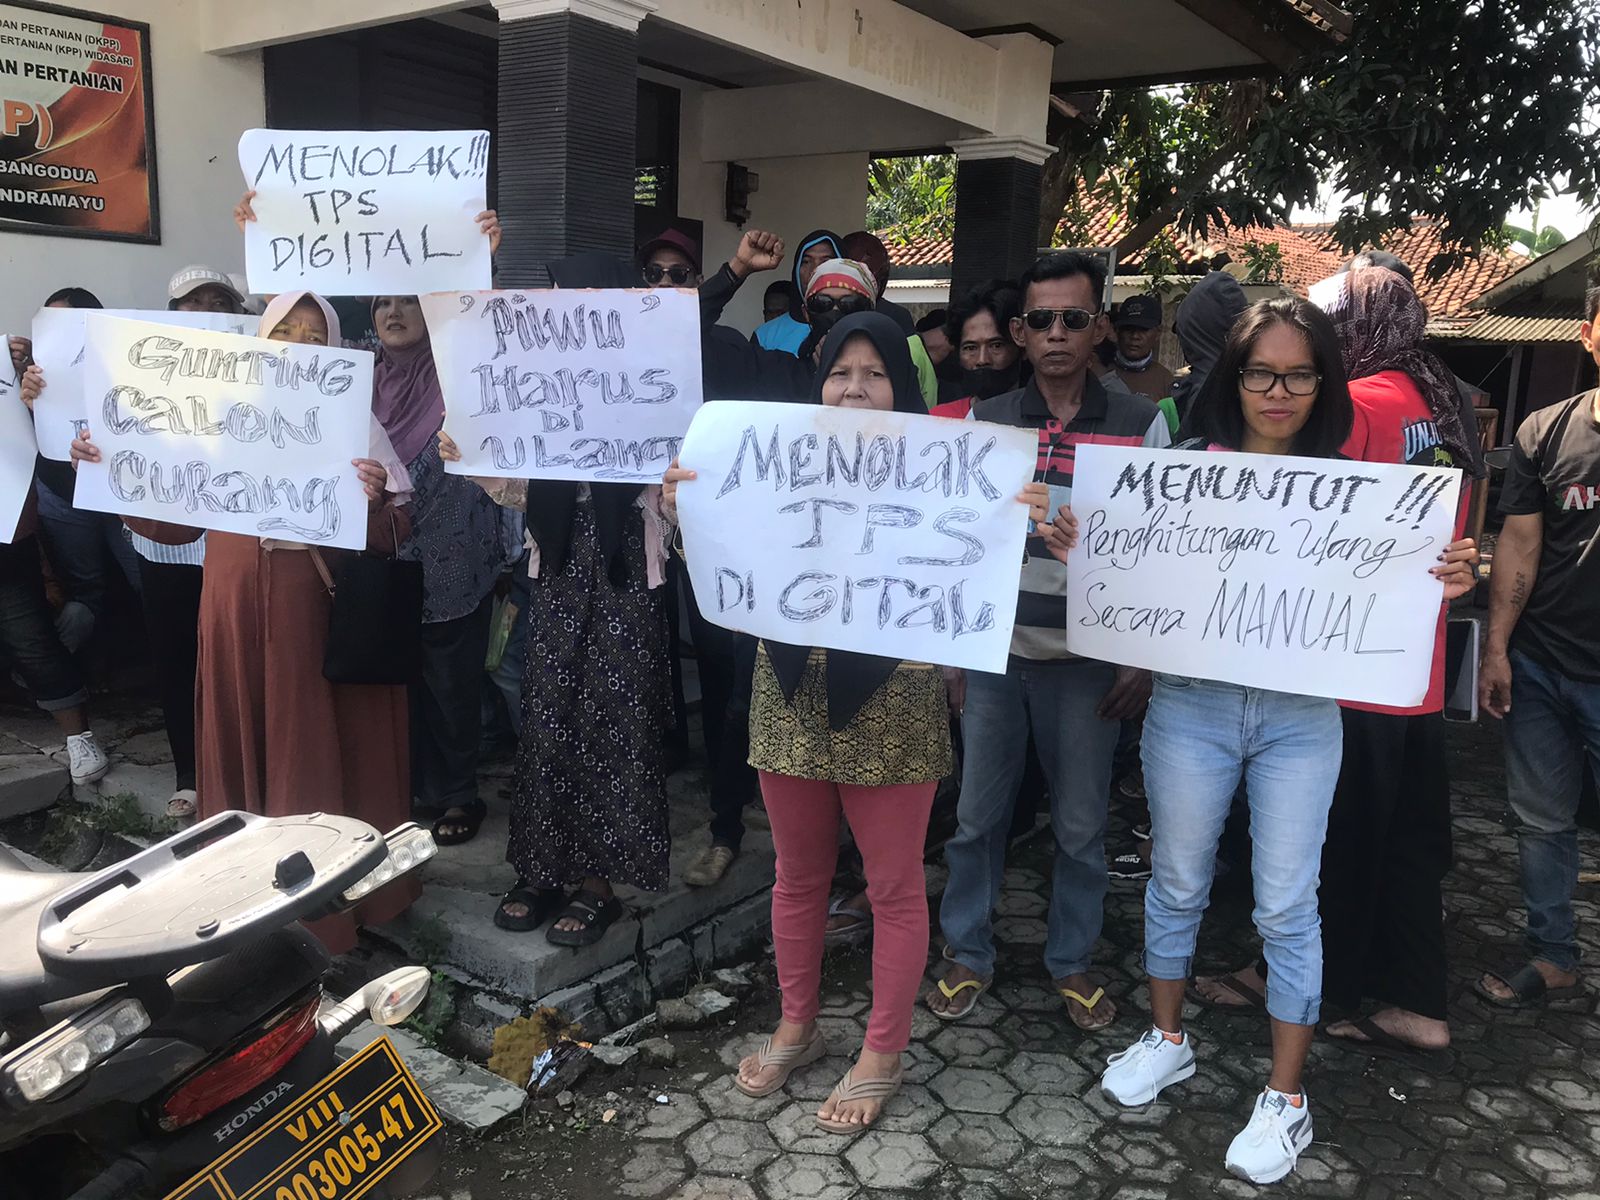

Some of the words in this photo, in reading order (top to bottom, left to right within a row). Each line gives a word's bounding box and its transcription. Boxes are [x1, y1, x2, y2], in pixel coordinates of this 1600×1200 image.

[0, 19, 18, 30] AN
[21, 22, 82, 42] PERTANIAN
[84, 34, 120, 51] (DKPP)
[55, 44, 82, 58] (KPP)
[84, 49, 133, 66] WIDASARI
[24, 62, 123, 92] PERTANIAN
[0, 160, 98, 183] BANGODUA
[0, 188, 105, 211] NDRAMAYU
[302, 189, 379, 225] TPS
[1110, 462, 1381, 515] MENUNTUT
[777, 497, 986, 567] TPS
[1081, 503, 1280, 580] Penghitungan
[1079, 582, 1187, 637] Secara
[1201, 578, 1405, 655] MANUAL
[212, 1080, 295, 1143] HONDA
[284, 1090, 345, 1142] VIII
